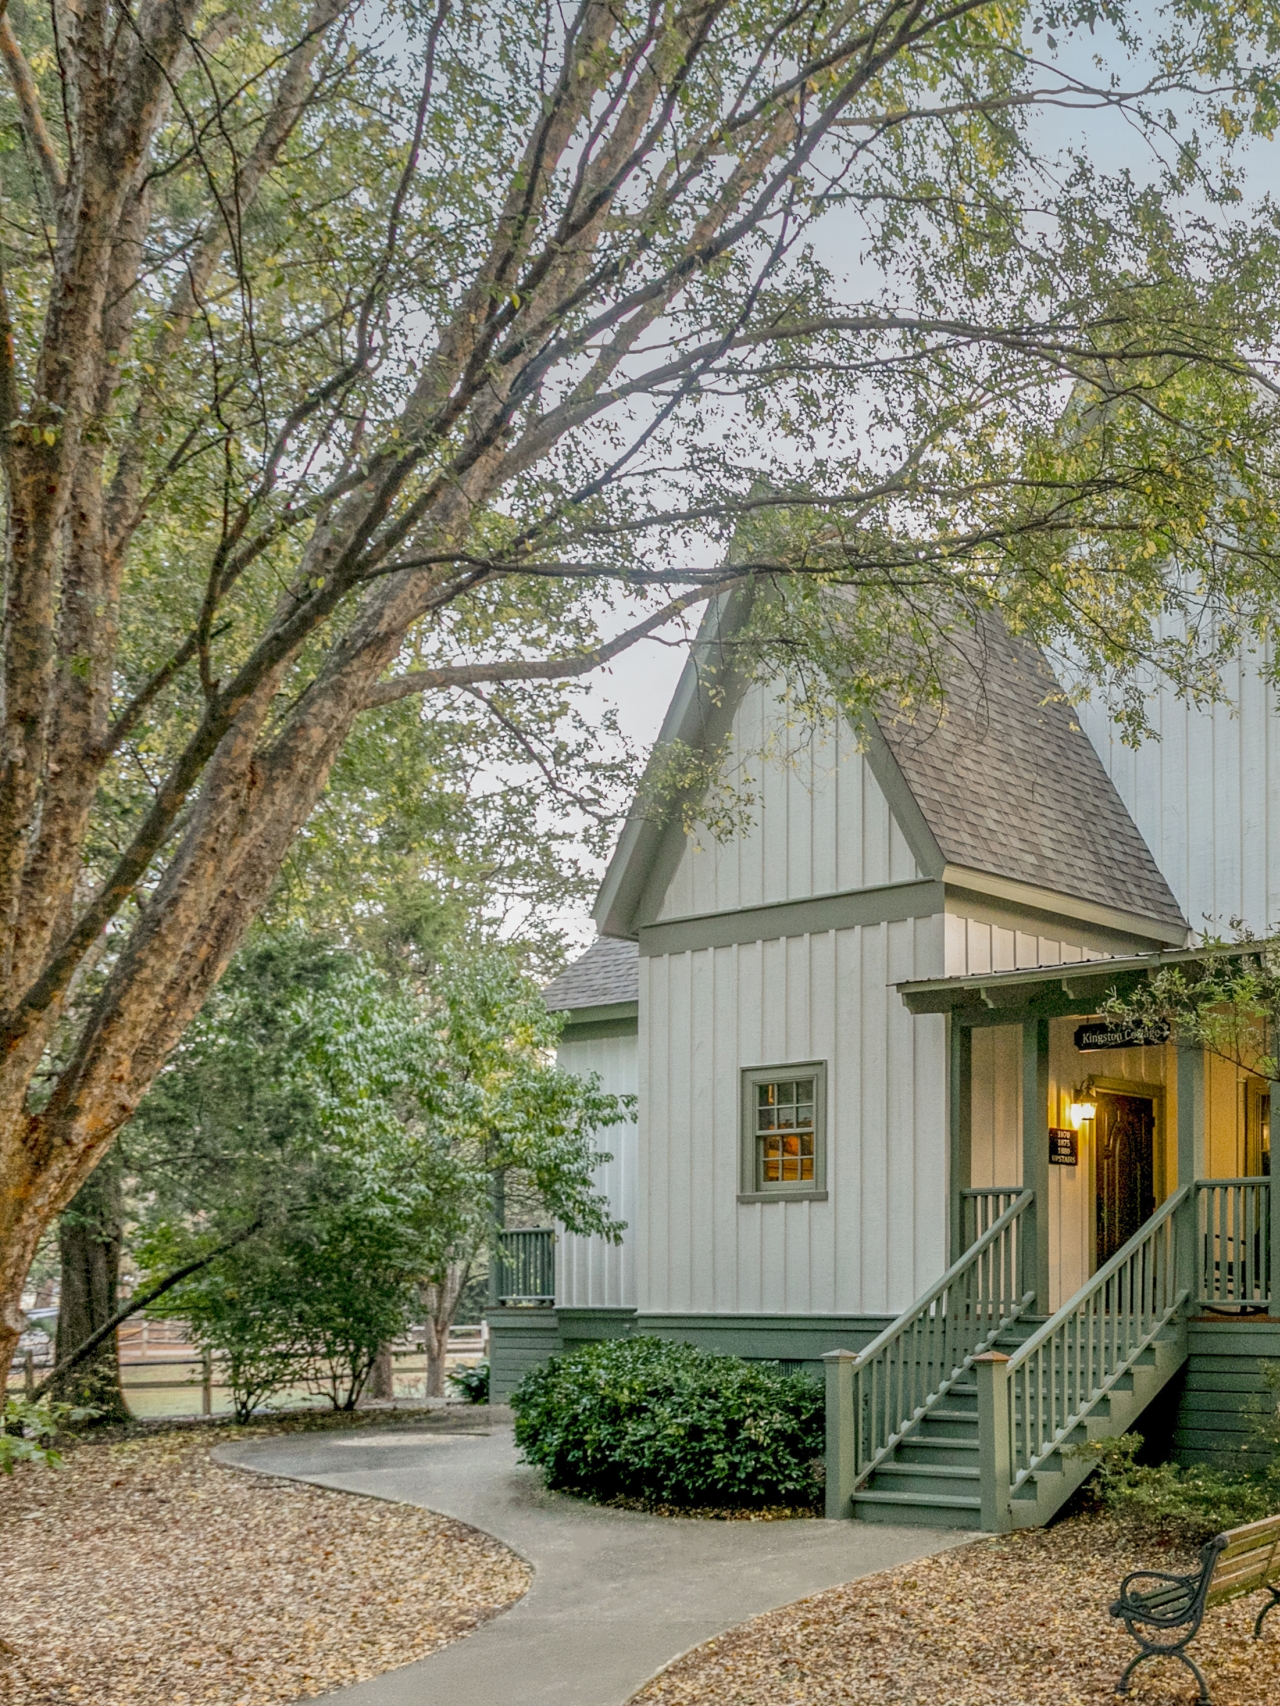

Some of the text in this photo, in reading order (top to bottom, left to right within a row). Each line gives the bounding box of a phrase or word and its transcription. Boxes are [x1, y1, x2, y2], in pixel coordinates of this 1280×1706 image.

[1082, 1029, 1161, 1045] Kingston Coage
[1051, 1155, 1076, 1164] UPSTAIRS
